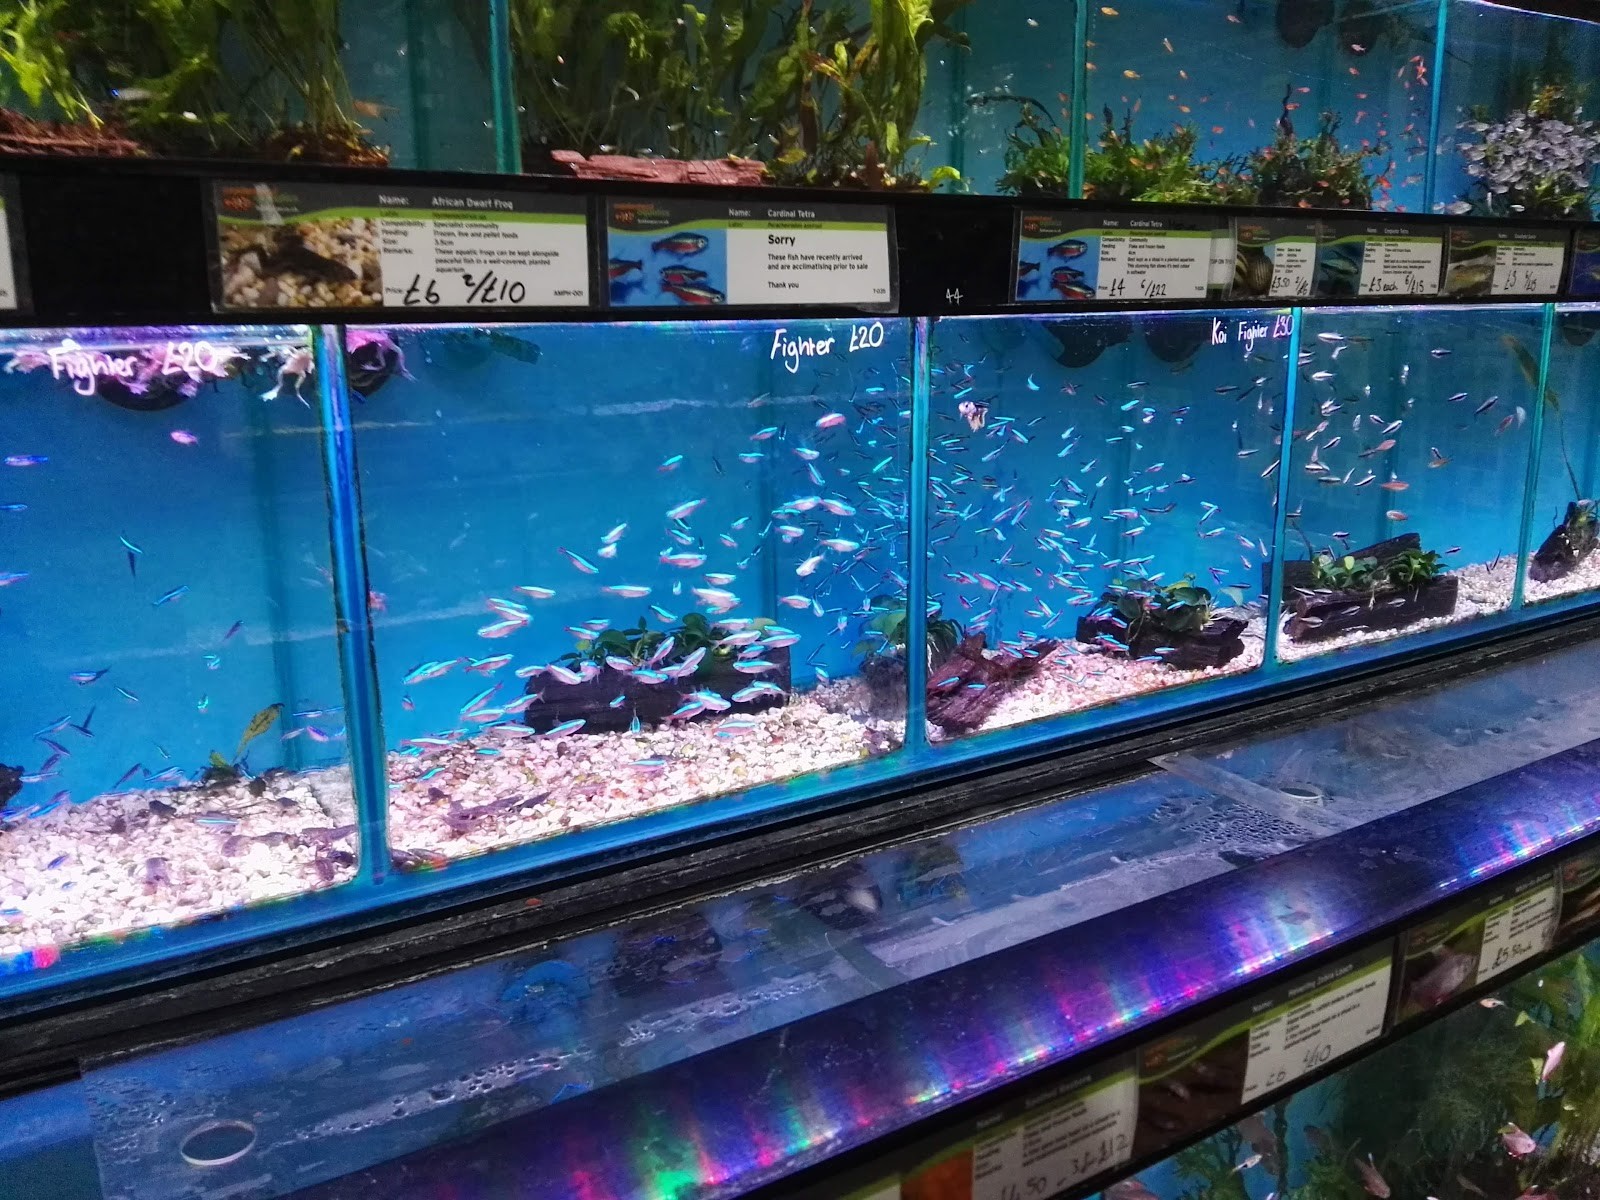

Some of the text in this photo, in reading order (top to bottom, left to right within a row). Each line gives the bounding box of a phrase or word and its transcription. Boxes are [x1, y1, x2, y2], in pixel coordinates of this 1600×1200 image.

[379, 194, 513, 211] Name: African Dwarf Frog
[728, 208, 816, 219] Name: Cardinal Tetra
[1129, 219, 1150, 228] Cardinal
[1150, 220, 1163, 228] Tetra
[767, 234, 796, 247] Sorry
[517, 250, 531, 258] kept
[767, 253, 786, 261] These
[787, 253, 799, 261] fish
[800, 253, 815, 261] have
[816, 254, 840, 263] recently
[463, 257, 475, 265] fish
[792, 263, 832, 271] acclimatising
[403, 273, 440, 305] £6
[787, 282, 800, 290] you
[1211, 314, 1295, 352] Koi Fighter £30
[770, 321, 884, 374] Fighter £20
[47, 337, 219, 397] Fighter £20
